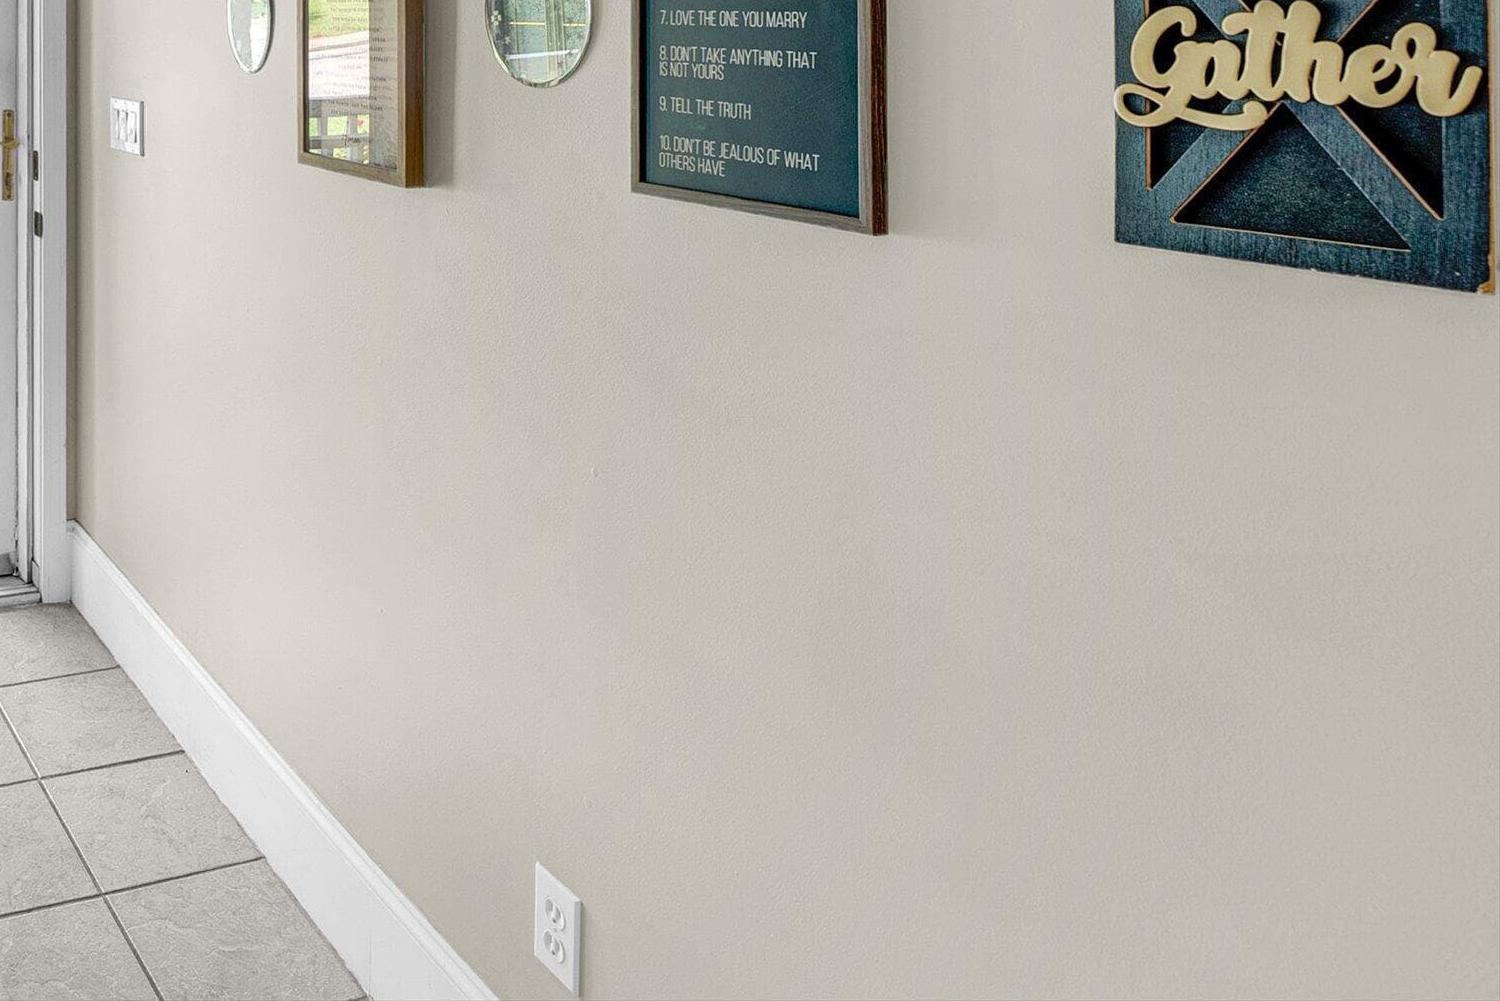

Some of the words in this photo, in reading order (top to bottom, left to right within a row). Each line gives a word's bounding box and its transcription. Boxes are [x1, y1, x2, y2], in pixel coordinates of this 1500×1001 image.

[660, 10, 668, 25] 7.
[670, 10, 695, 26] LOVE
[698, 10, 717, 27] THE
[719, 11, 739, 27] ONE
[741, 11, 765, 28] YOU
[766, 11, 808, 29] MARRY
[659, 45, 668, 61] 8.
[670, 46, 699, 63] DON'T
[700, 47, 726, 64] TAKE
[730, 49, 783, 68] ANYTHING
[786, 51, 818, 70] THAT
[1114, 0, 1484, 130] Gather
[659, 62, 668, 76] IS
[670, 63, 689, 78] NOT
[691, 63, 725, 80] YOURS
[659, 96, 668, 112] 9.
[670, 97, 693, 115] TELL
[695, 99, 715, 117] THE
[717, 101, 751, 120] TRUTH
[659, 135, 671, 151] 10.
[673, 136, 702, 155] DON'T
[703, 140, 716, 157] BE
[718, 142, 764, 164] JEALOUS
[767, 149, 781, 166] OF
[783, 151, 820, 172] WHAT
[659, 154, 695, 173] OTHERS
[698, 158, 726, 178] HAVE
